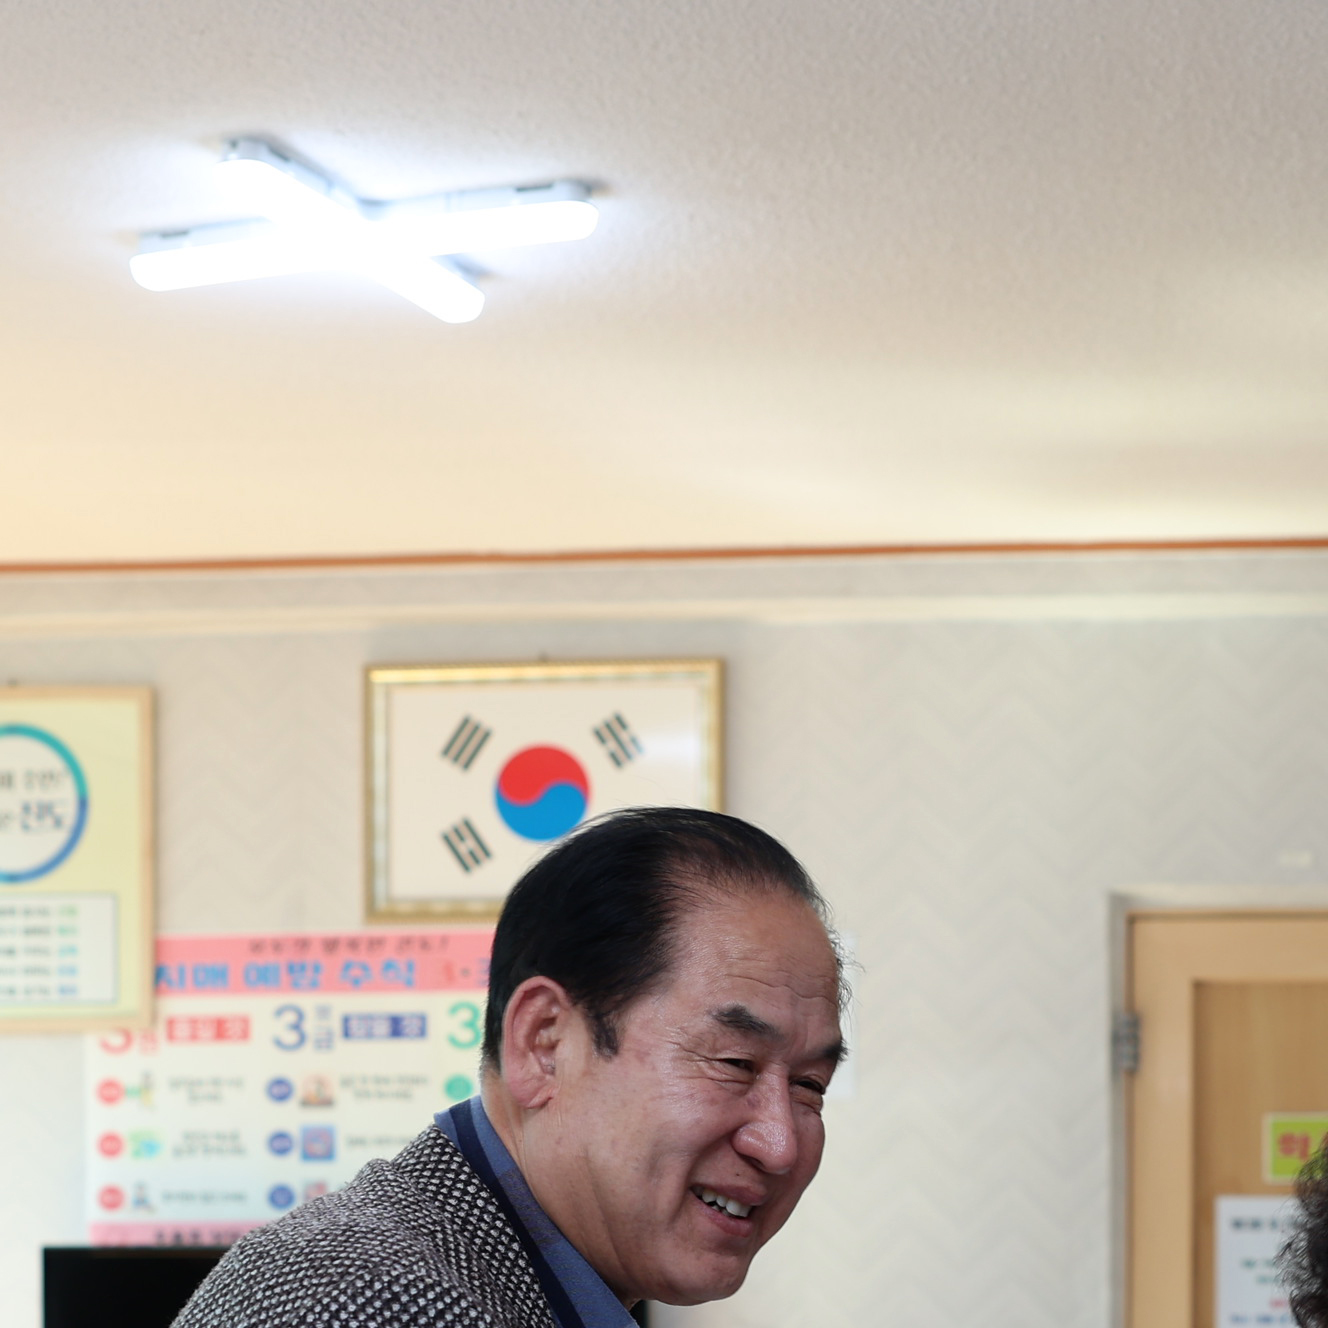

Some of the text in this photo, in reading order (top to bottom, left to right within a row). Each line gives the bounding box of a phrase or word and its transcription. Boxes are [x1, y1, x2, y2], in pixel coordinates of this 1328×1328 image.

[243, 960, 323, 990] 예방
[339, 957, 416, 989] 수칙
[273, 1004, 307, 1052] 3
[447, 1001, 483, 1049] 3
